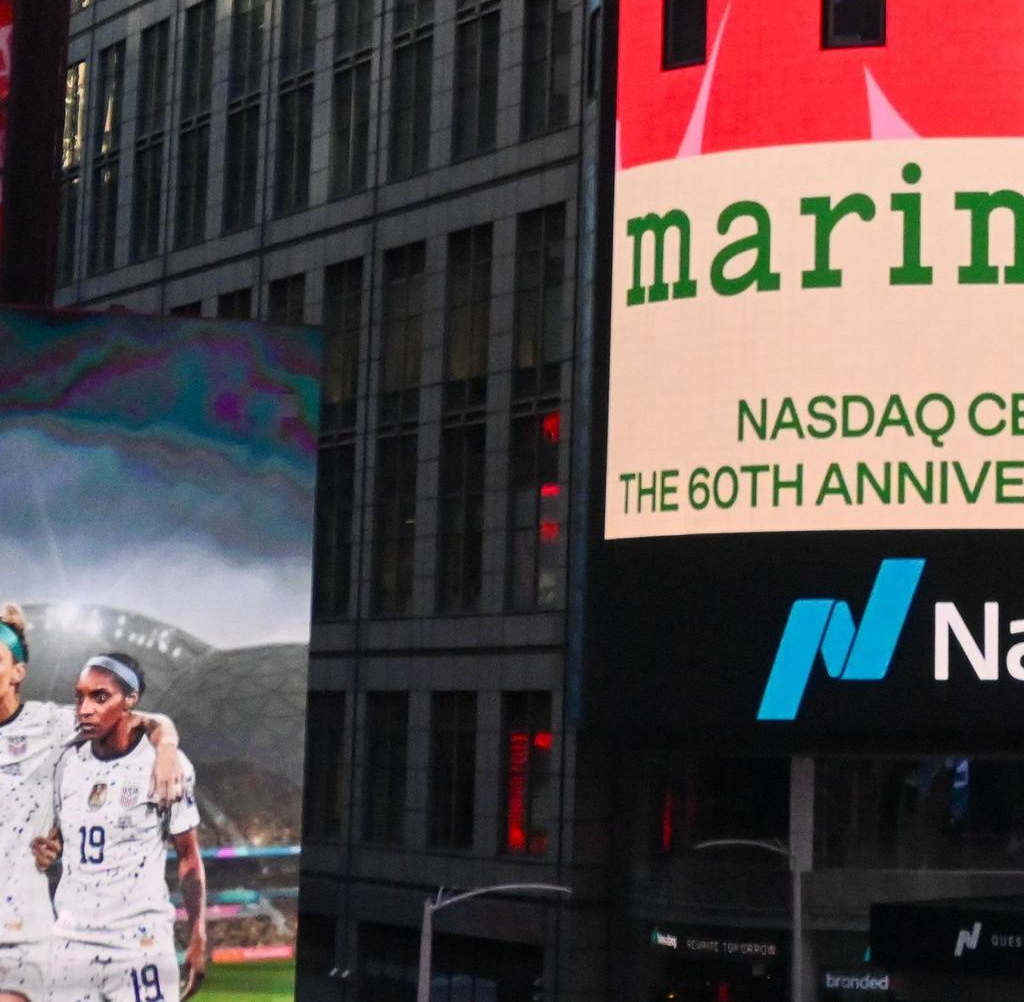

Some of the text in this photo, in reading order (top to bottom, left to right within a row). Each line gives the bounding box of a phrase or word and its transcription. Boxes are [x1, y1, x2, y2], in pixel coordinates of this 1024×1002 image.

[736, 393, 956, 446] NASDAQ
[619, 471, 679, 515] THE
[688, 464, 804, 511] 60TH
[79, 825, 106, 865] 19
[131, 963, 165, 1002] 19
[825, 972, 890, 991] branded
